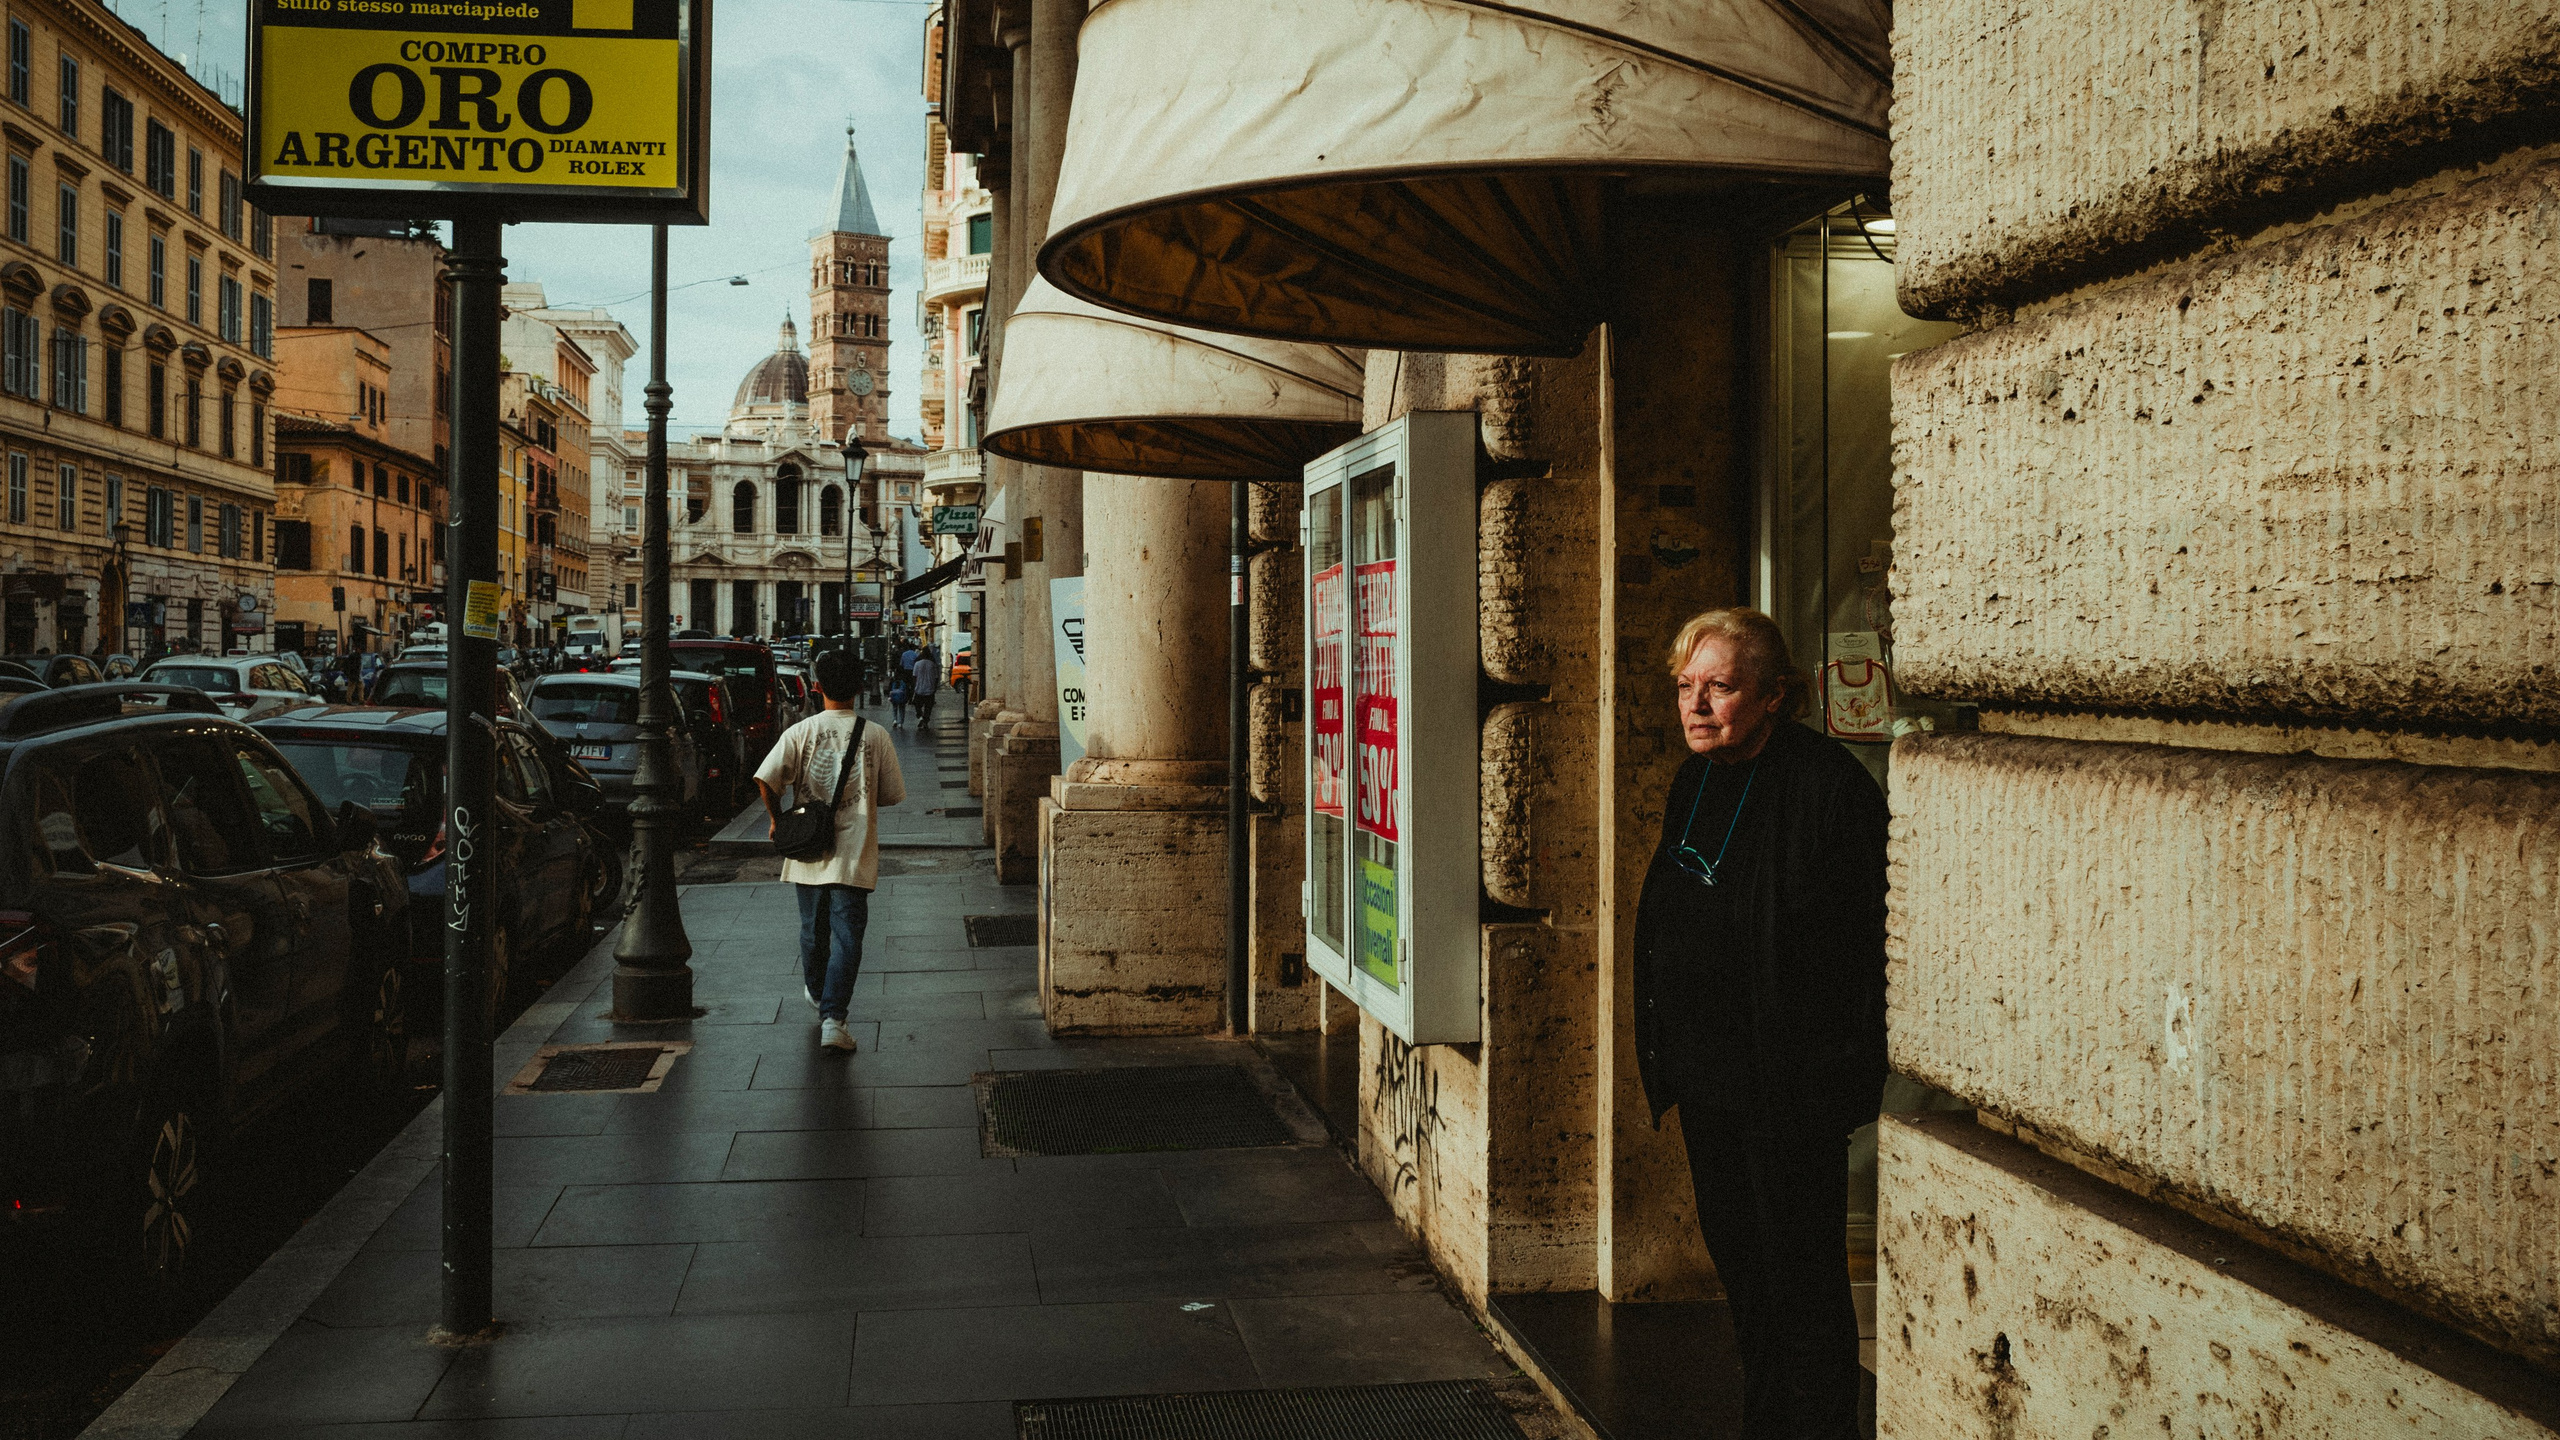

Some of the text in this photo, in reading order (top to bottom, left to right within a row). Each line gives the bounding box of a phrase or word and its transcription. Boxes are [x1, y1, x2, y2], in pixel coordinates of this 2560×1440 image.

[277, 0, 540, 21] sullo stesso marciapiede
[400, 40, 547, 66] COMPRO
[348, 63, 594, 135] ORO
[274, 131, 545, 173] ARGENTO
[549, 141, 666, 156] DIAMANTI
[568, 160, 646, 176] ROLEX
[934, 507, 976, 524] Pizza
[1360, 636, 1397, 698] TUTTO
[1359, 742, 1399, 830] 50%
